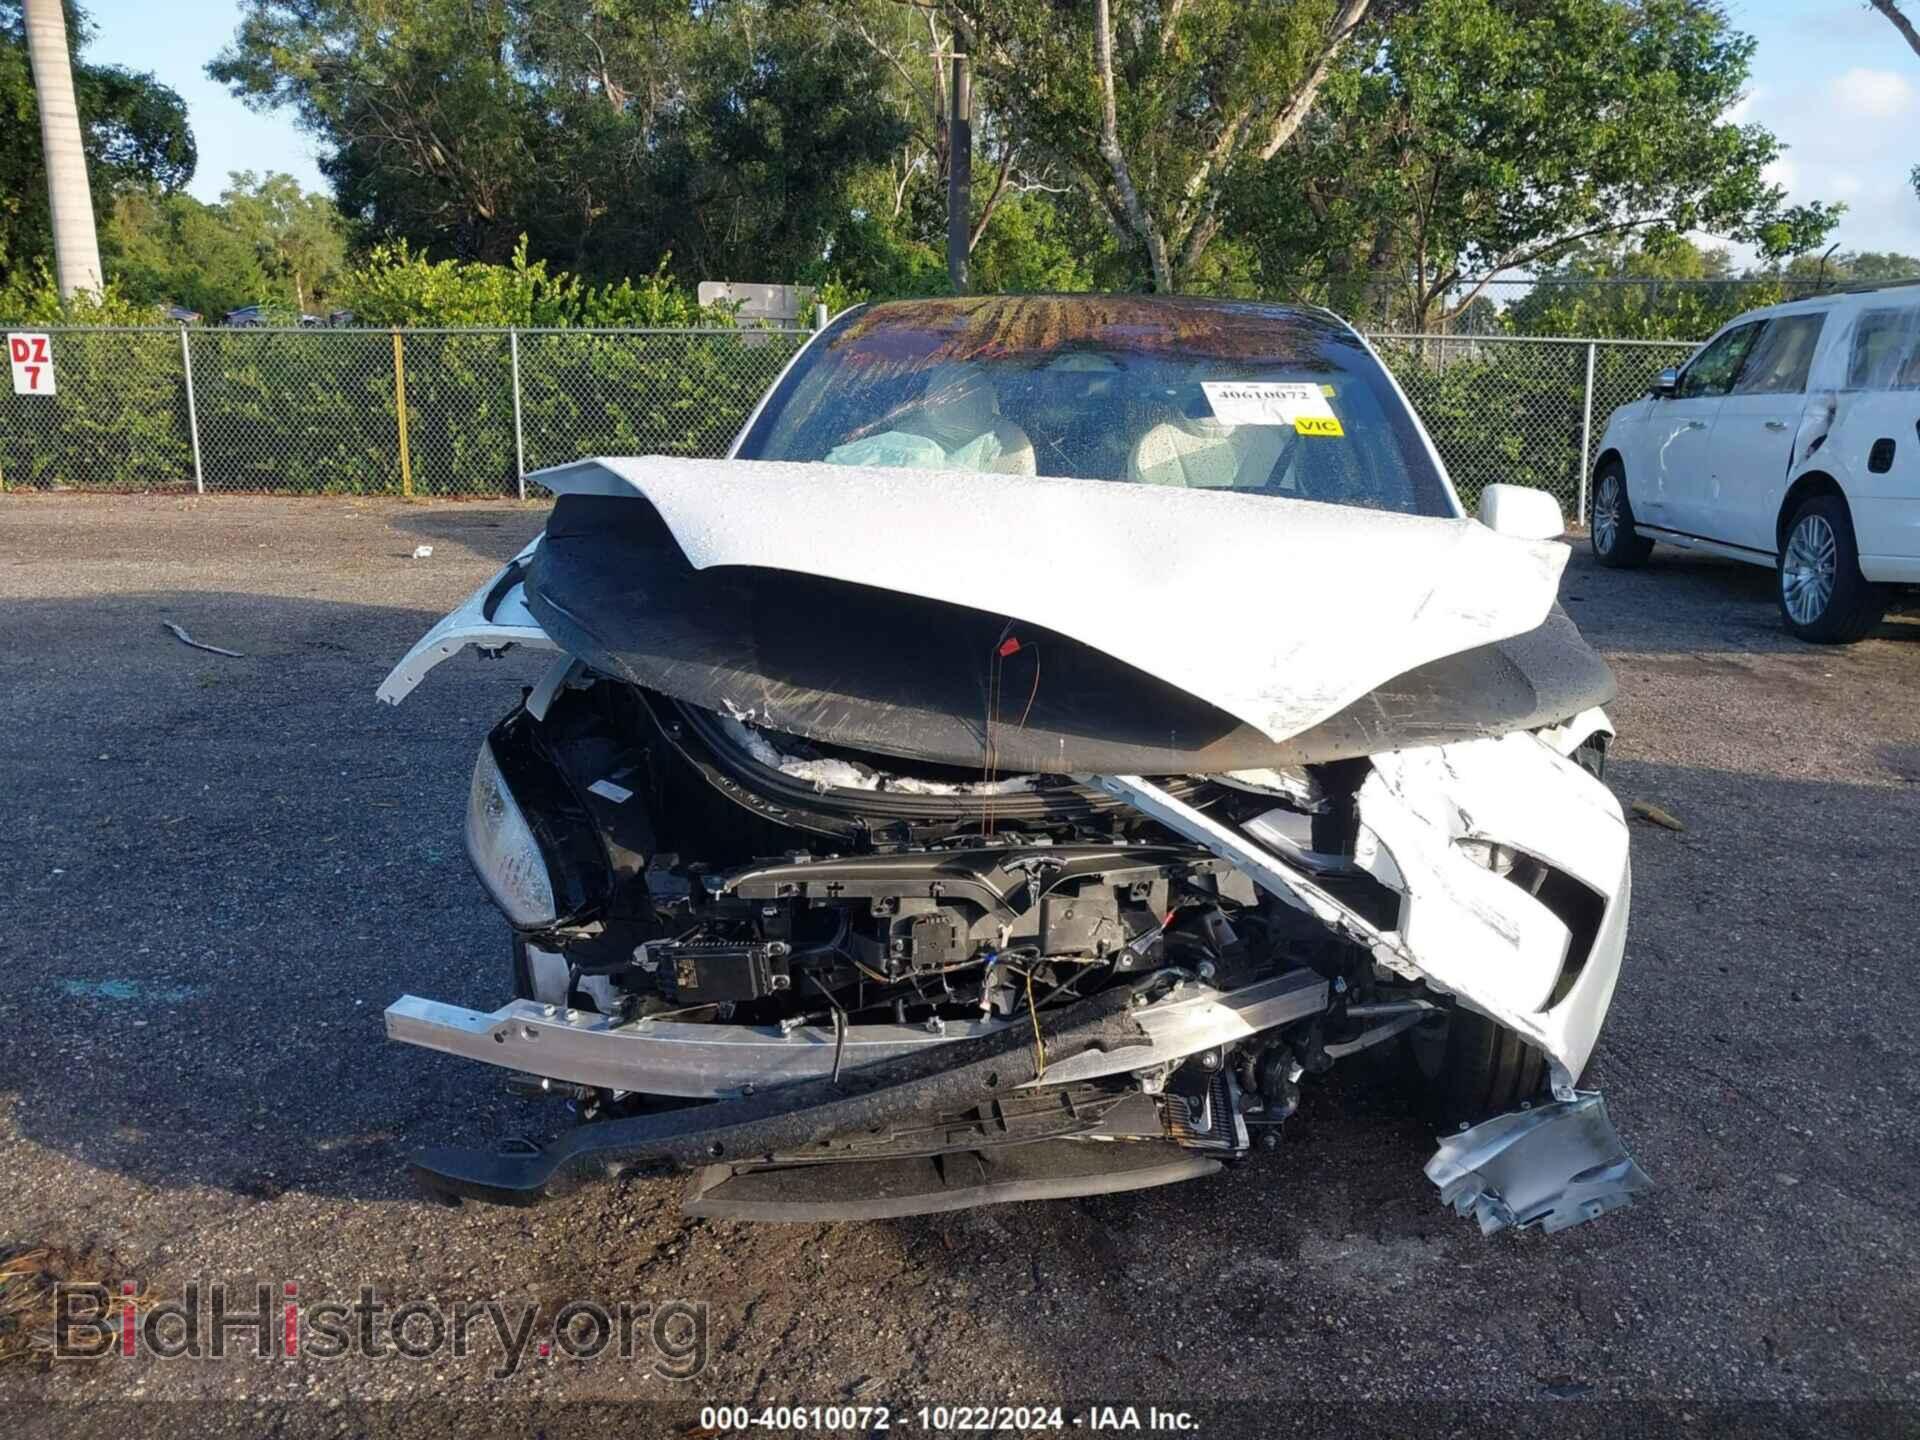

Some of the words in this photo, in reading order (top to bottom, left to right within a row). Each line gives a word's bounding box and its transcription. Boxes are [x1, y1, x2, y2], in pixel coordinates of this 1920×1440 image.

[11, 338, 48, 362] DZ
[24, 366, 40, 389] 7
[1219, 391, 1311, 400] 40610072
[1297, 419, 1338, 432] VIC
